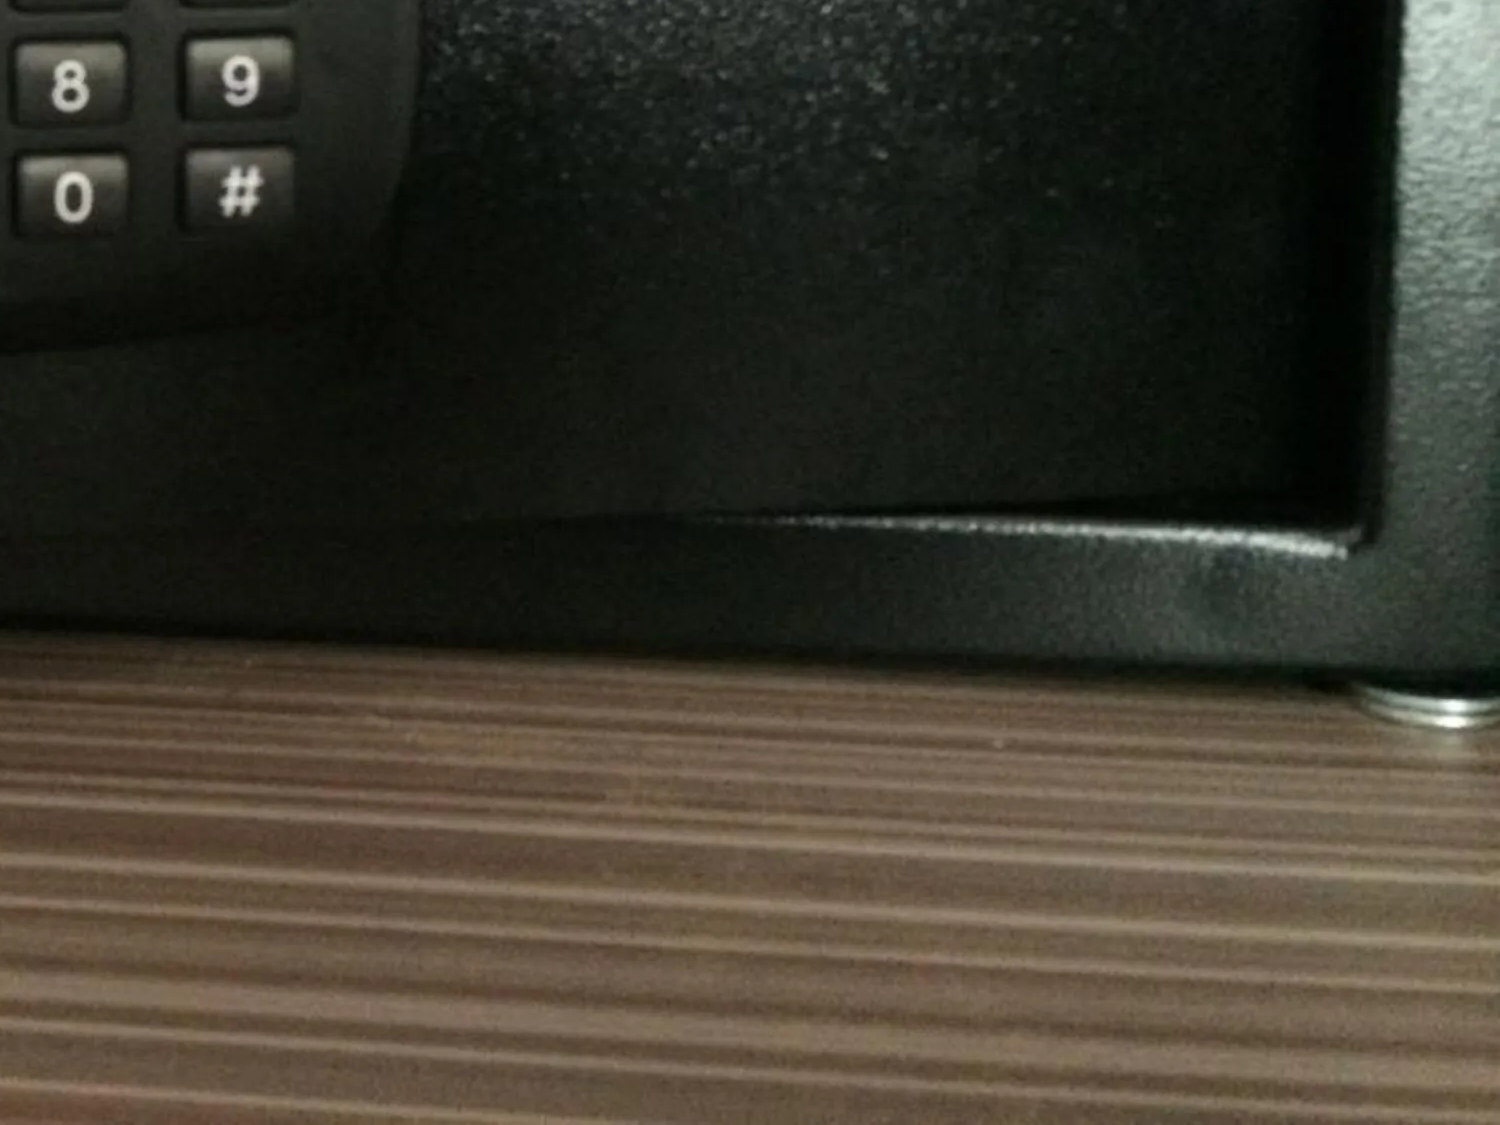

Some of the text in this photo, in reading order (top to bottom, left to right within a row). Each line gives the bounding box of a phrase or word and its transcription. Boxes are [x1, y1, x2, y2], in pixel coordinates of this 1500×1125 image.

[50, 60, 90, 112] 8
[220, 55, 260, 106] 9
[53, 171, 93, 223] 0
[218, 165, 263, 217] #
